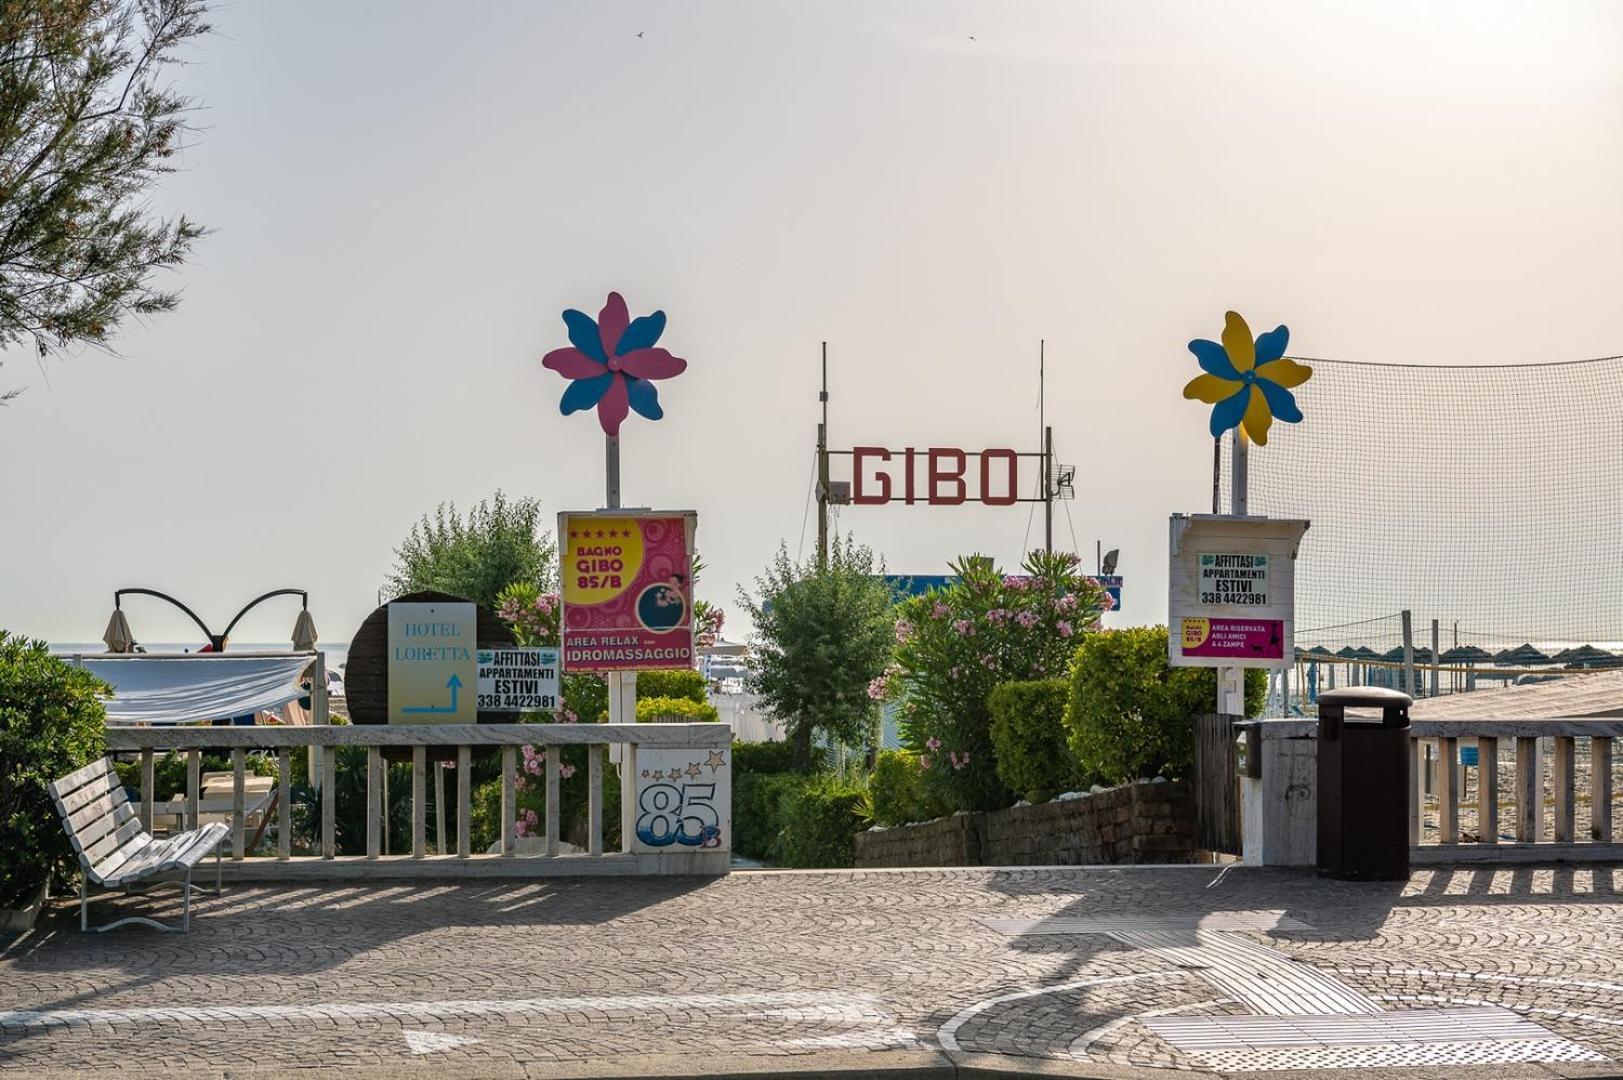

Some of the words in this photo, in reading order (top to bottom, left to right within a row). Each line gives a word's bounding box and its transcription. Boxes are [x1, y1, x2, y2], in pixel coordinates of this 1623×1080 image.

[853, 446, 1018, 506] GIBO
[576, 546, 623, 557] BAGNO
[576, 559, 624, 574] GIBO
[1215, 555, 1254, 568] AFFITTASI
[1203, 569, 1265, 579] APPARTAMENTI
[577, 575, 622, 589] 85/B
[1216, 580, 1253, 592] ESTIVI
[1201, 592, 1222, 604] 338
[1223, 593, 1266, 605] 4422981
[405, 623, 461, 637] HOTEL
[1211, 624, 1229, 632] AREA
[1230, 624, 1266, 632] RISERVATA
[566, 637, 597, 647] AREA
[601, 636, 639, 646] RELAX
[395, 647, 471, 661] LORETTA
[493, 651, 540, 666] AFFITTASI
[566, 647, 690, 661] IDROMASSAGGIO
[479, 668, 554, 679] APPARTAMENTI
[494, 680, 538, 694] ESTIVI
[477, 695, 500, 708] 338
[504, 695, 555, 708] 4422981
